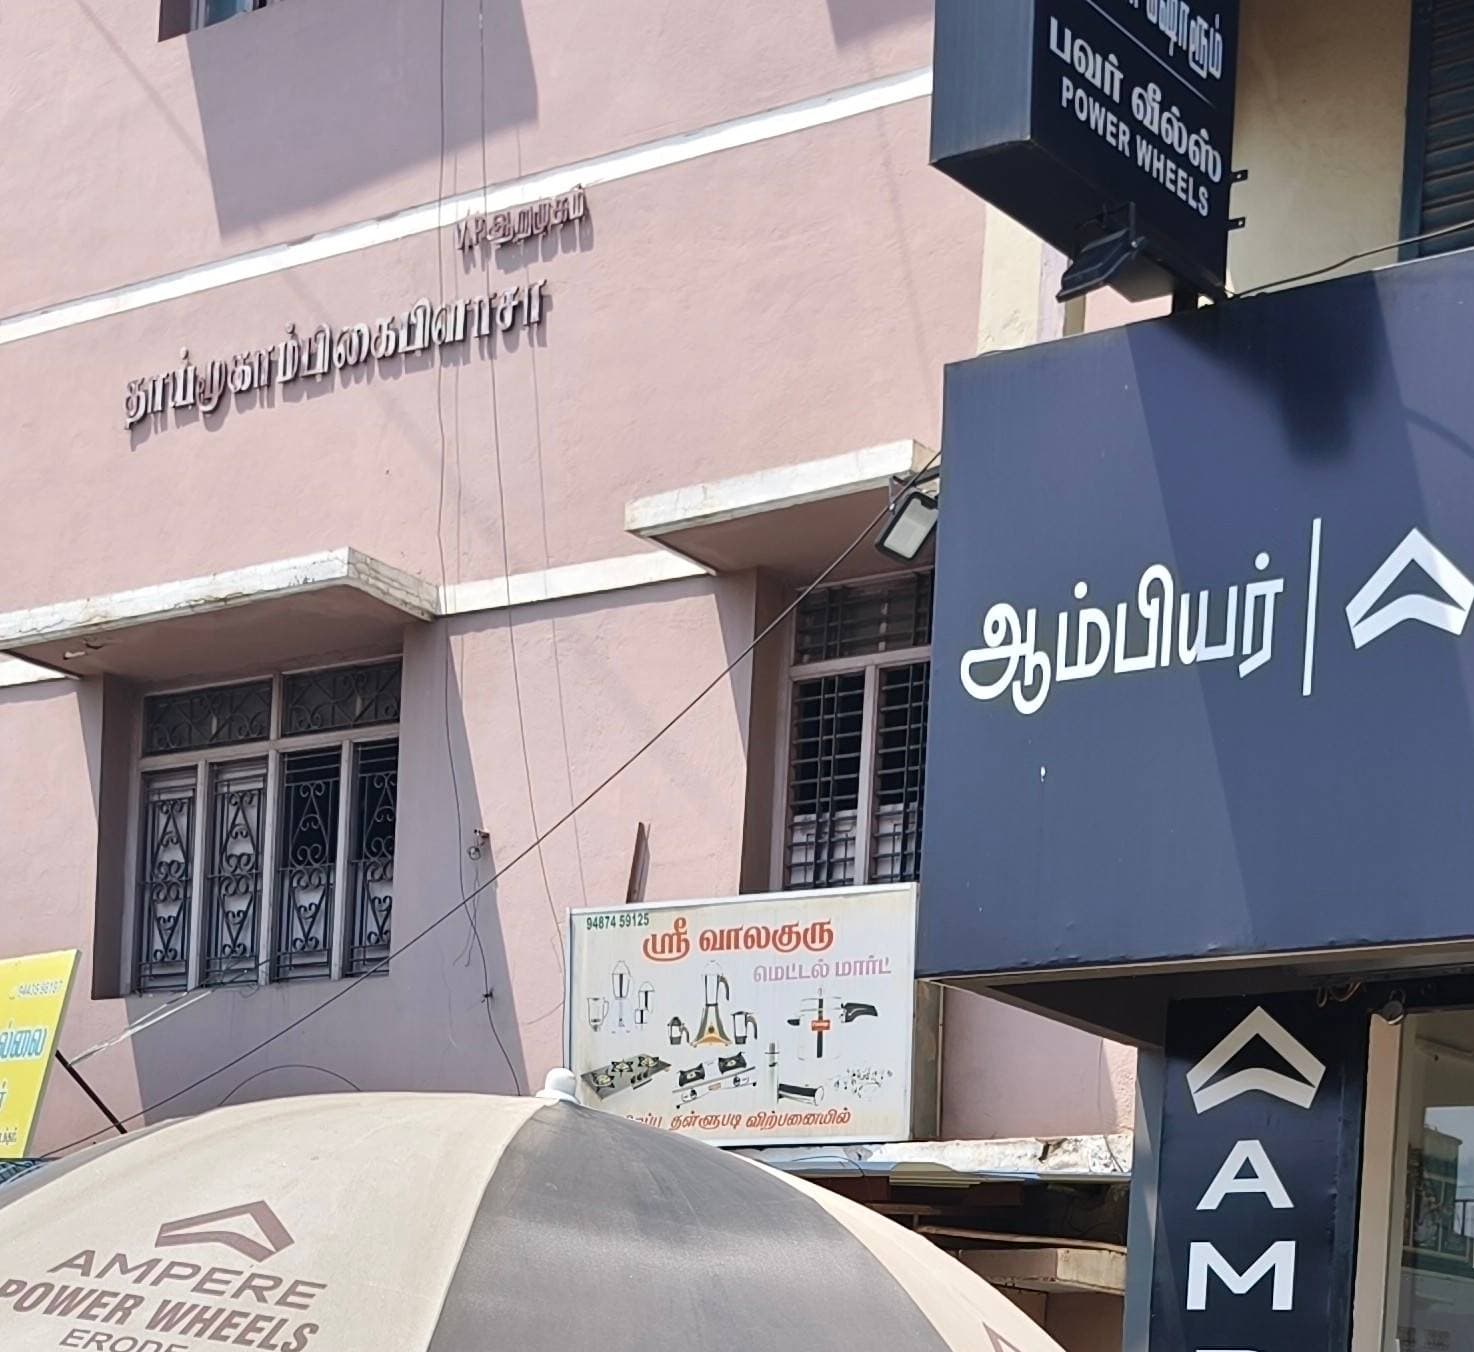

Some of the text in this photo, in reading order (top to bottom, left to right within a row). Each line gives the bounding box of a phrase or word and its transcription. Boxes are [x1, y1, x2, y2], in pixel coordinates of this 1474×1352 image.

[1050, 16, 1222, 184] பவர் வீல்ஸ்
[1061, 76, 1209, 217] POWER WHEELS
[959, 551, 1285, 714] ஆம்பியர்
[586, 912, 650, 931] 94874 59125
[753, 956, 892, 983] மெட்டல் மார்ட்
[0, 1278, 145, 1327] POWER
[47, 1249, 329, 1311] AMPERE
